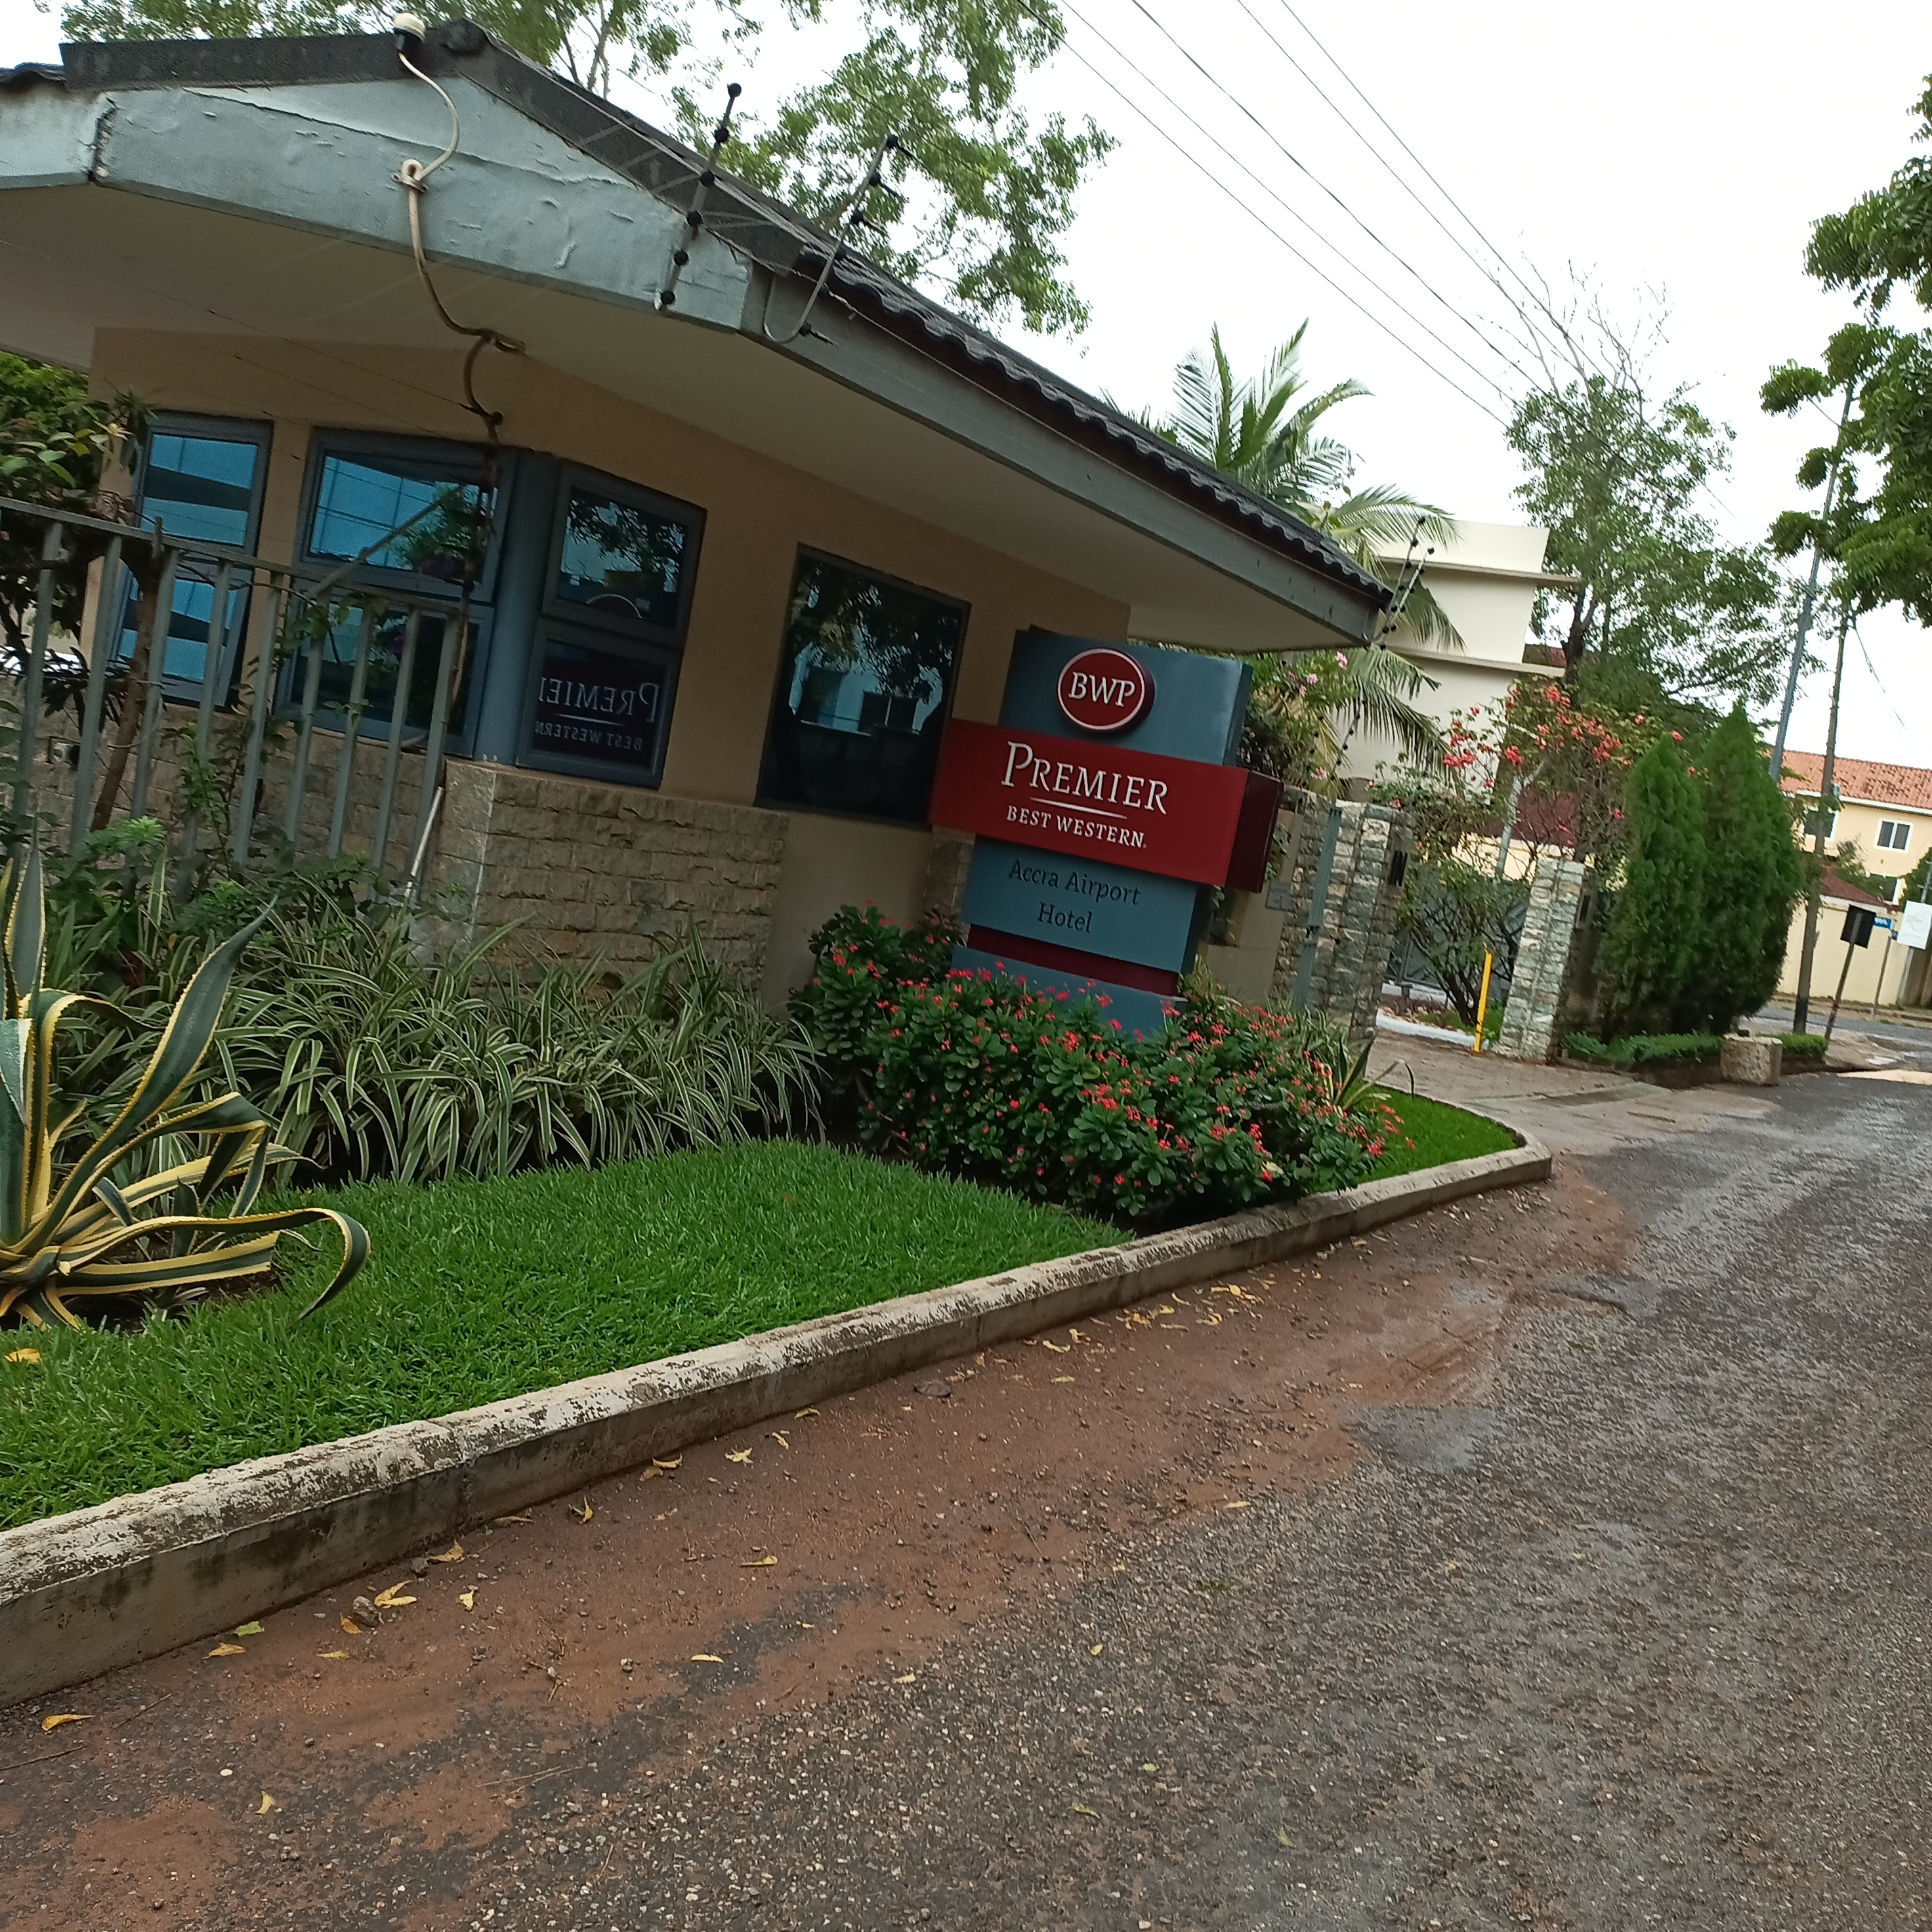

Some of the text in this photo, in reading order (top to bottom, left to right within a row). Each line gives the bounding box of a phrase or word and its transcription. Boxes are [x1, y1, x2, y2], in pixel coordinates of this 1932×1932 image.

[1068, 671, 1135, 707] BWP
[1001, 741, 1168, 815] PREMIER
[1006, 805, 1052, 829] BEST
[1008, 860, 1141, 906] Accra Airport
[1037, 901, 1093, 934] Hotel
